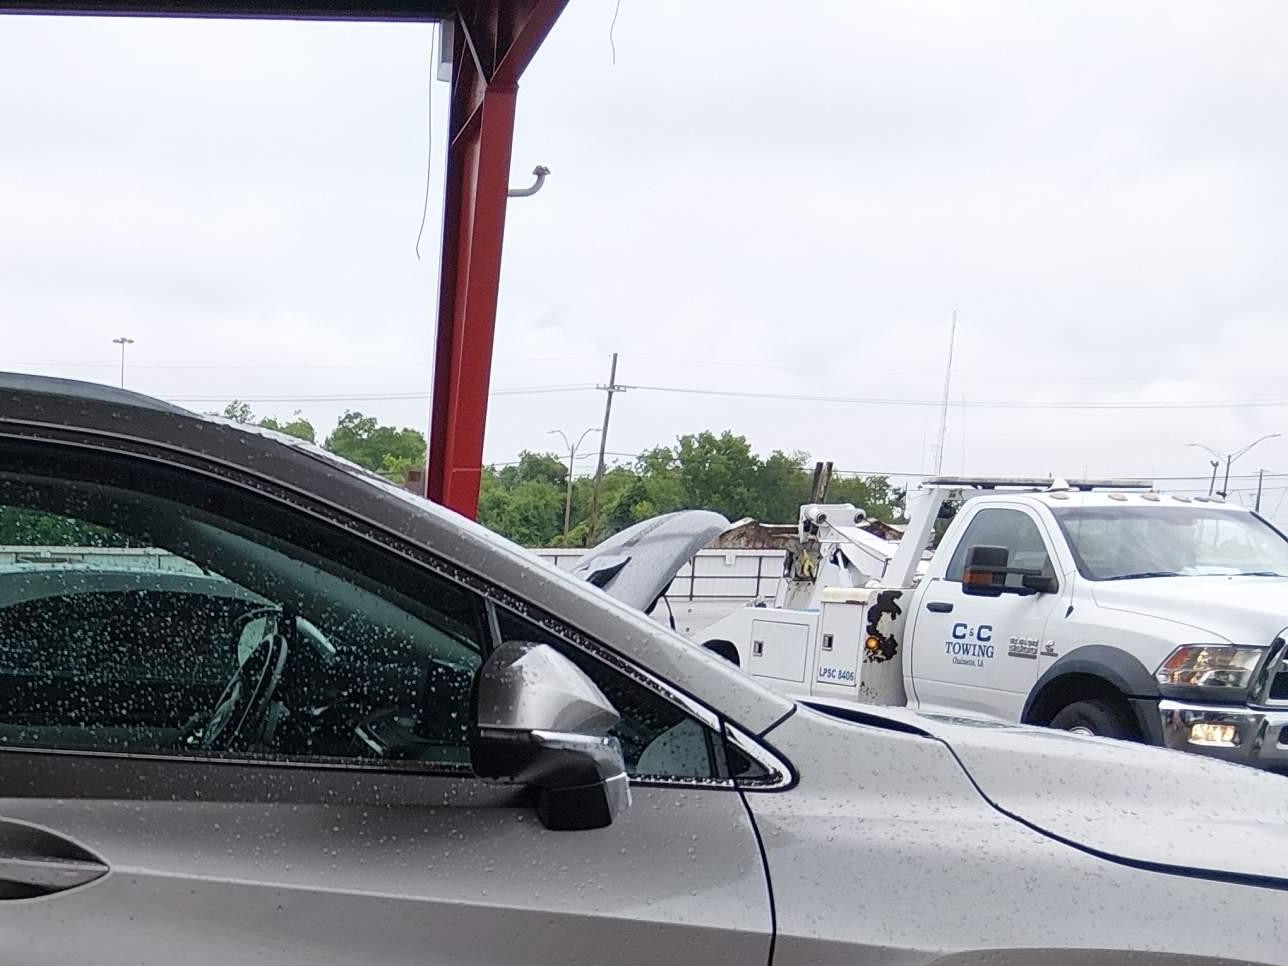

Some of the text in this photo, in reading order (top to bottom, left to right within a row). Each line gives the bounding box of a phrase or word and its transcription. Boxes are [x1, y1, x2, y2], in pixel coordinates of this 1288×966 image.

[952, 623, 968, 640] C
[977, 625, 993, 642] C
[945, 641, 995, 659] TOWING
[819, 666, 837, 678] LPSC
